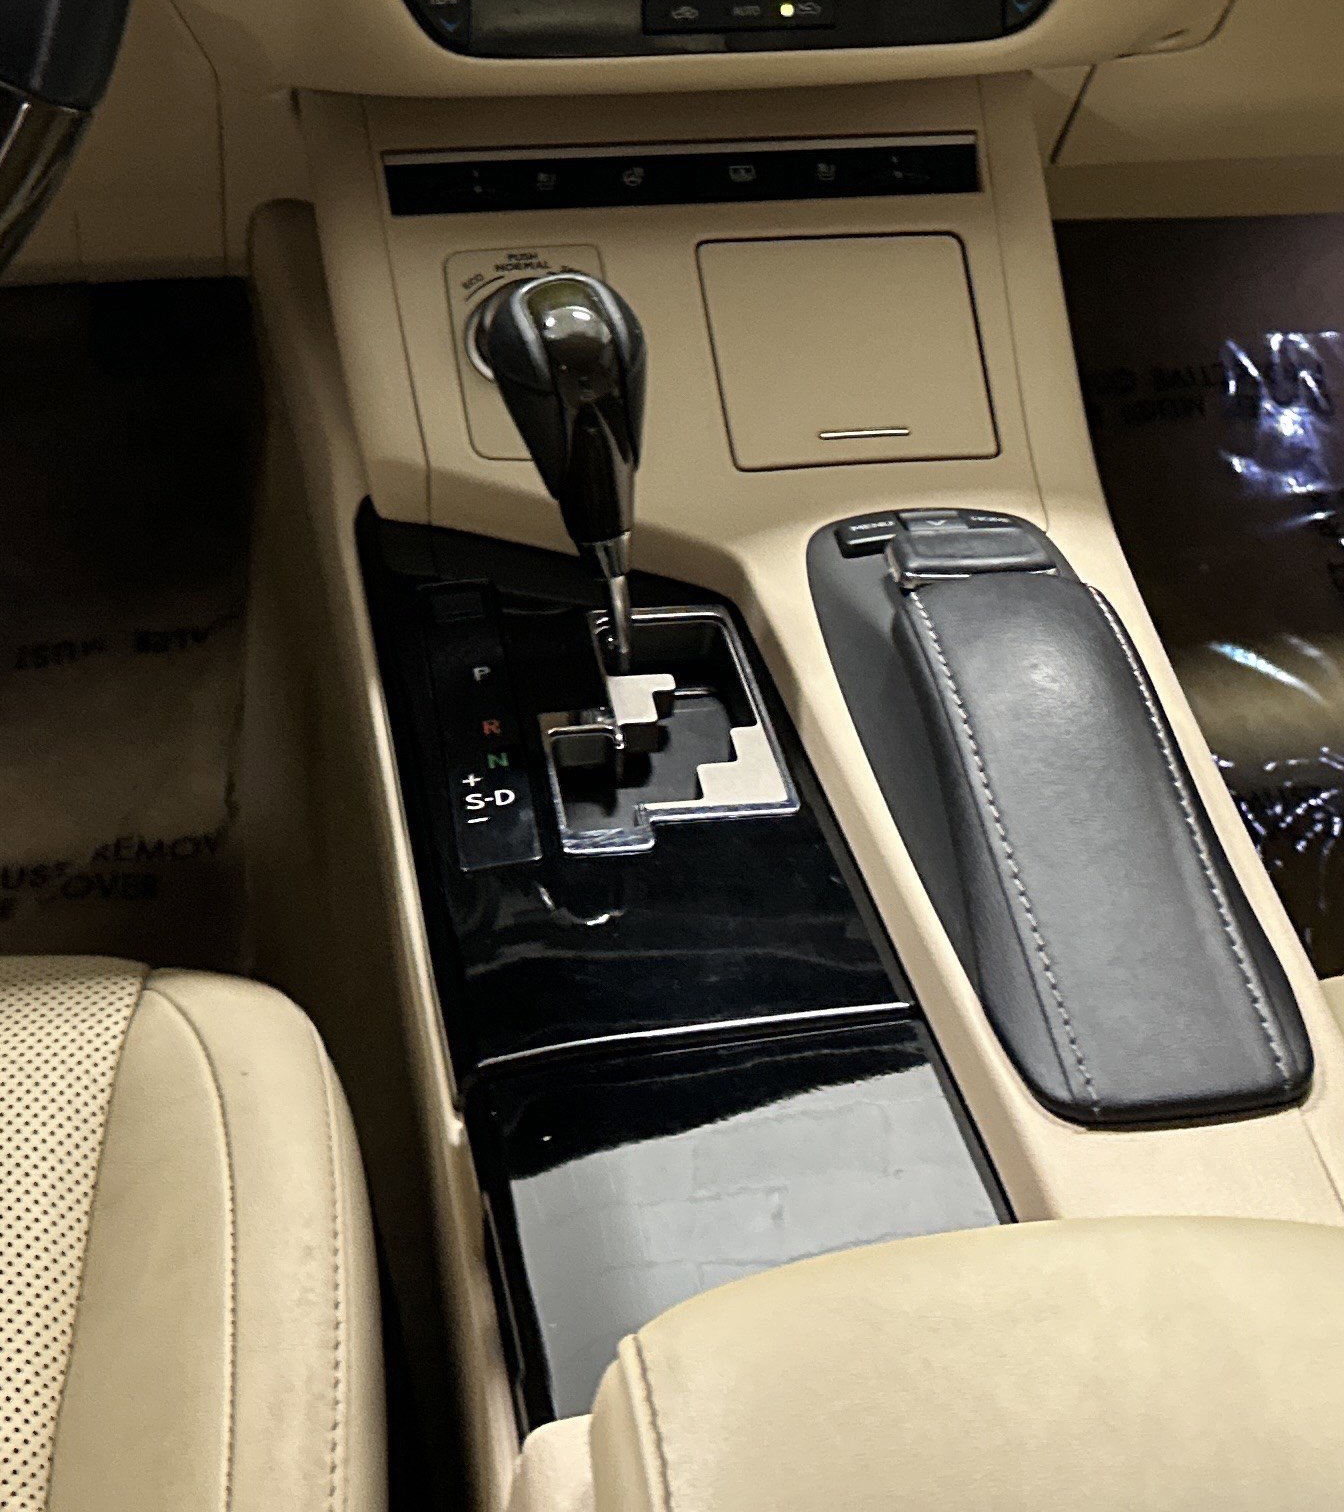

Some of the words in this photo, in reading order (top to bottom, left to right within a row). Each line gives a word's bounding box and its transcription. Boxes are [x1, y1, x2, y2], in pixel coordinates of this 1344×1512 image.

[494, 260, 551, 272] NORMAL
[472, 665, 492, 682] P
[482, 719, 502, 736] R
[487, 751, 509, 769] N
[464, 788, 516, 810] S-D
